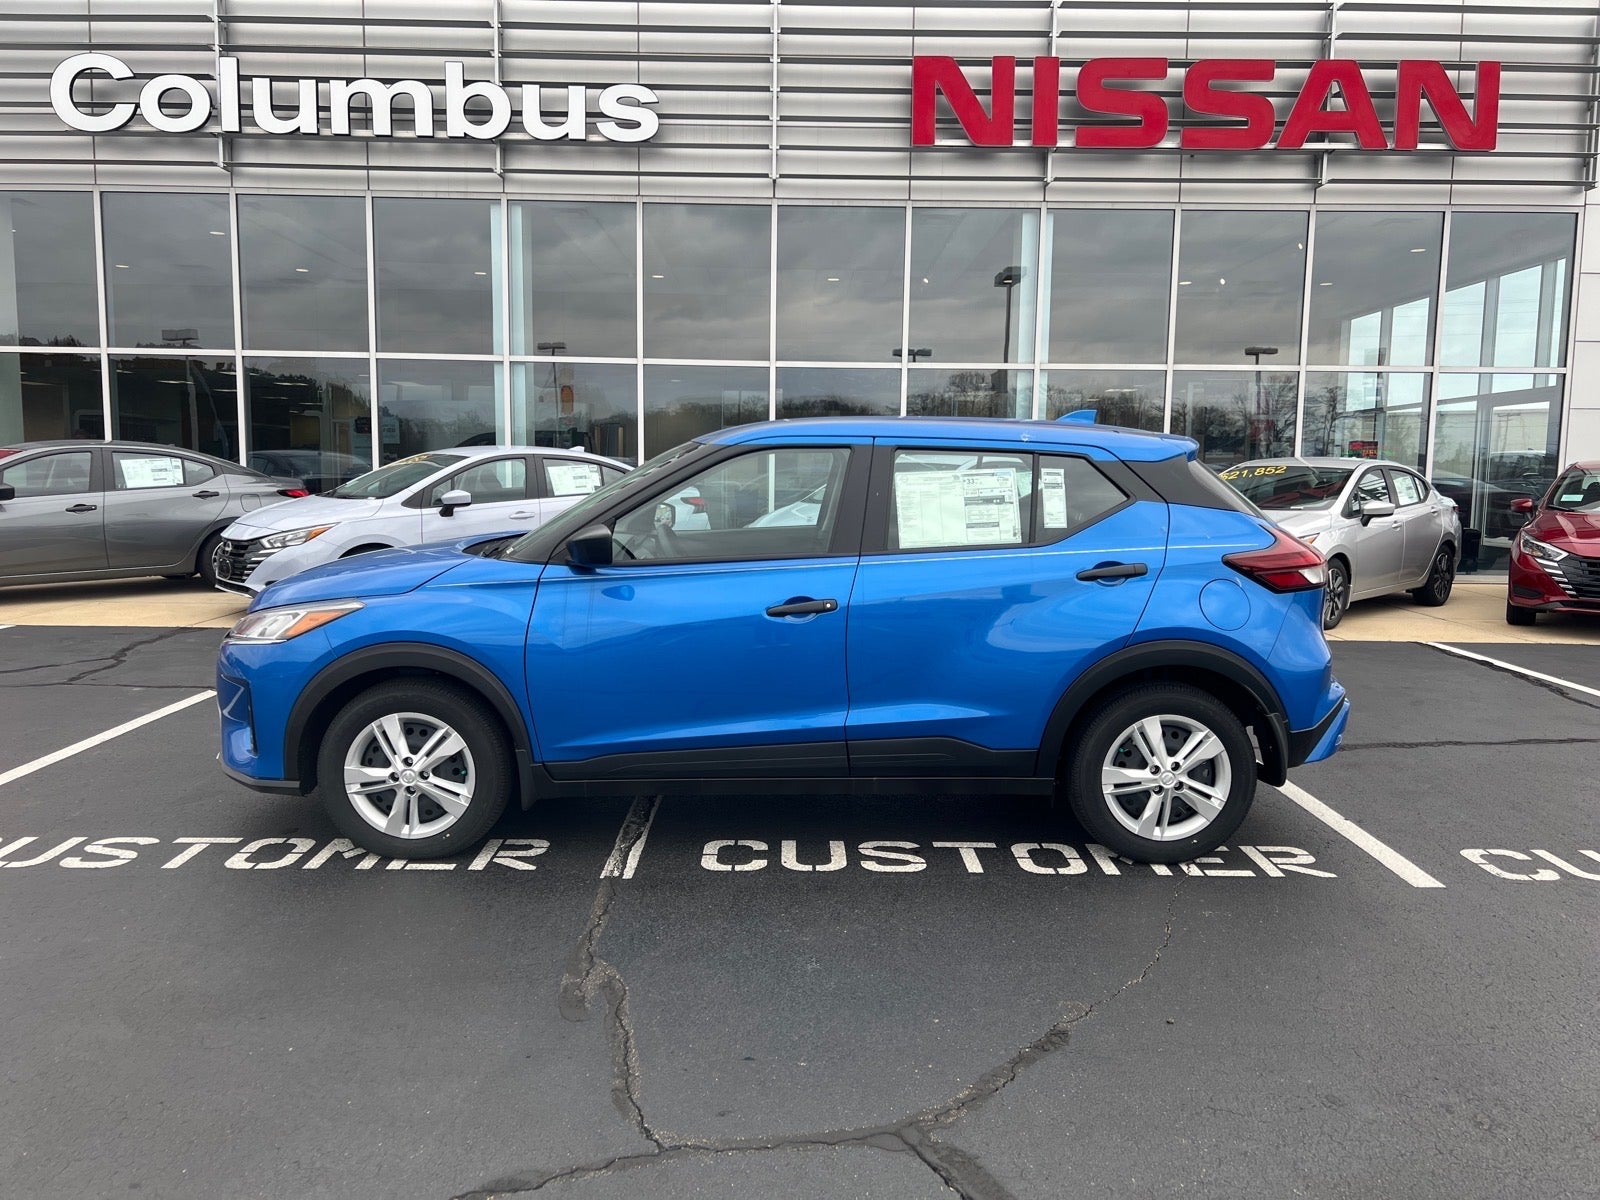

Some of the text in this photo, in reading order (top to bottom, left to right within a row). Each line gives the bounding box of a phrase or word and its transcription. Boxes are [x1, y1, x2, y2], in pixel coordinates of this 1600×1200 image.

[50, 53, 1501, 151] Columbus NISSAN
[0, 837, 551, 871] USTOMR
